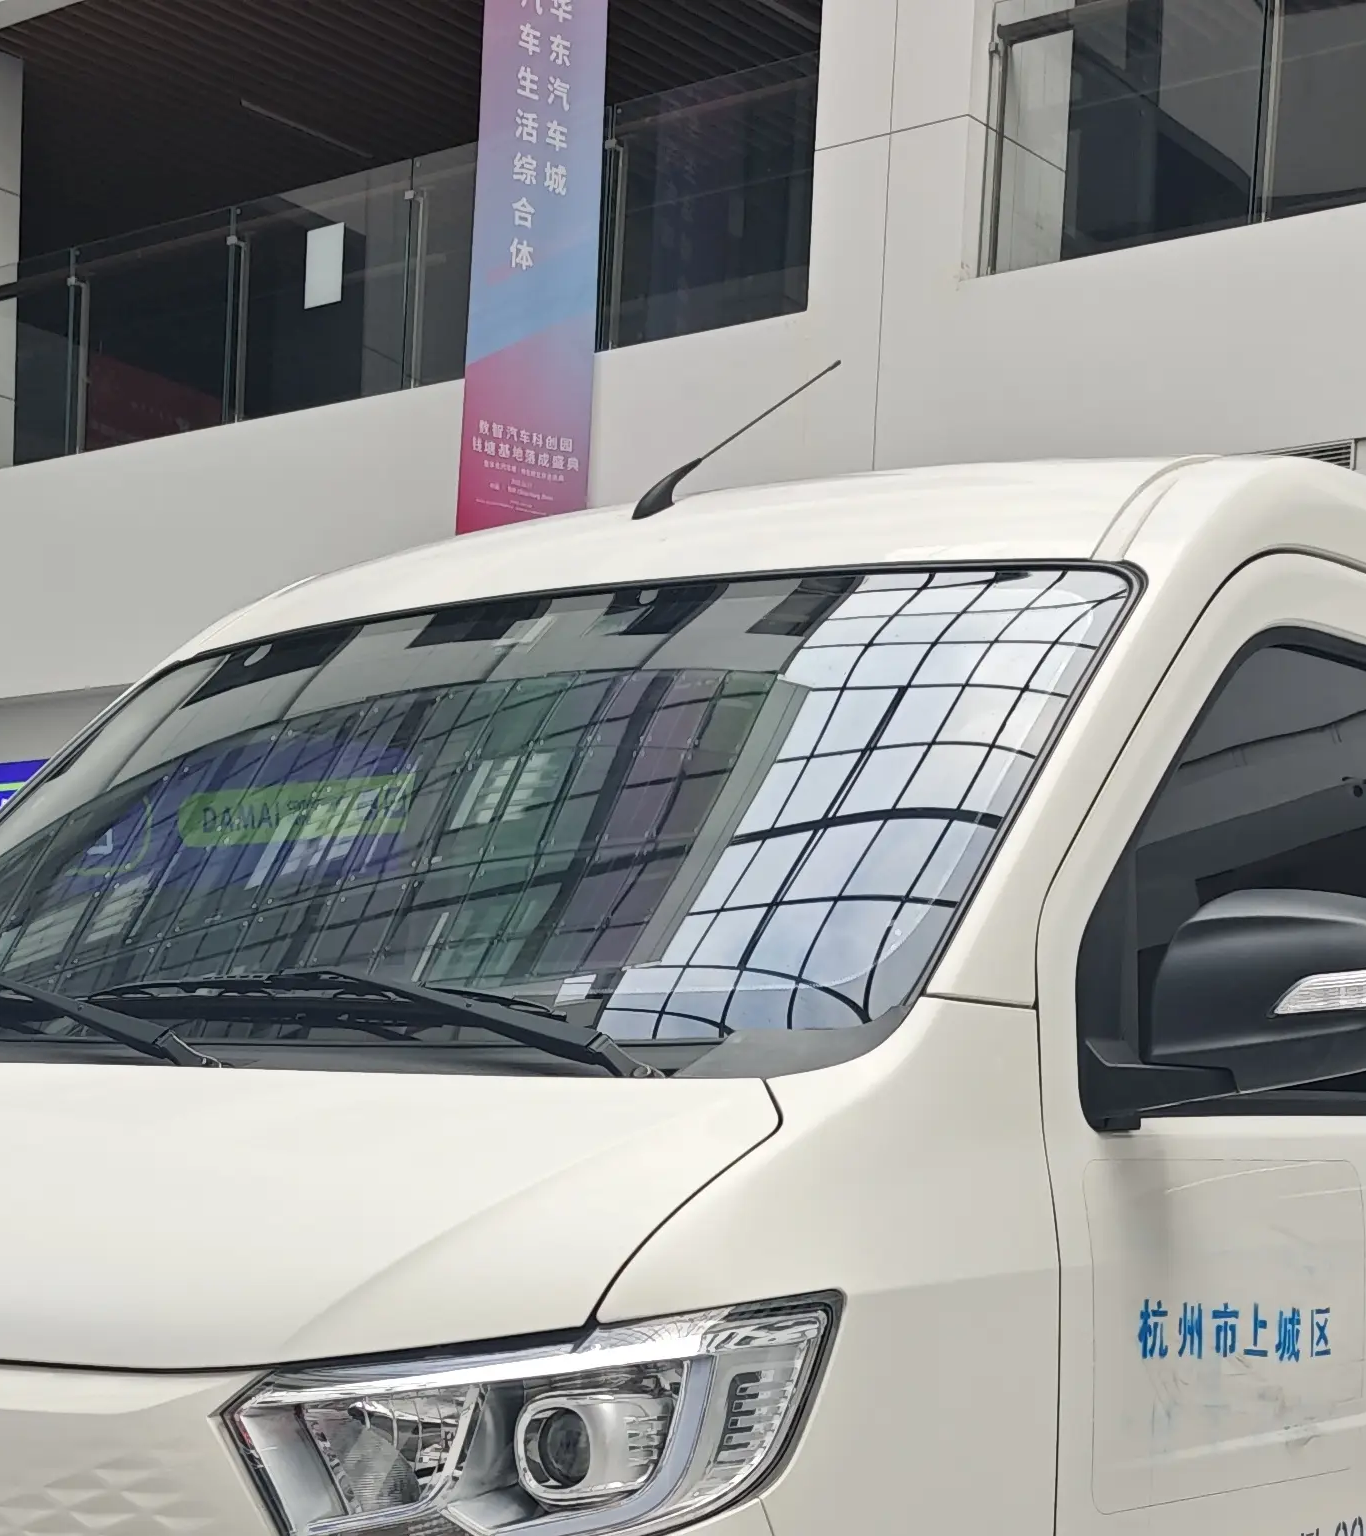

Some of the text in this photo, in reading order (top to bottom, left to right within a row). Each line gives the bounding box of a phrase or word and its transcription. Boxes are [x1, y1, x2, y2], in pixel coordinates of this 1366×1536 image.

[543, 0, 573, 196] 华东汽车城
[478, 419, 573, 452] 数智汽车科创园
[1137, 1297, 1333, 1363] 杭州市上城区
